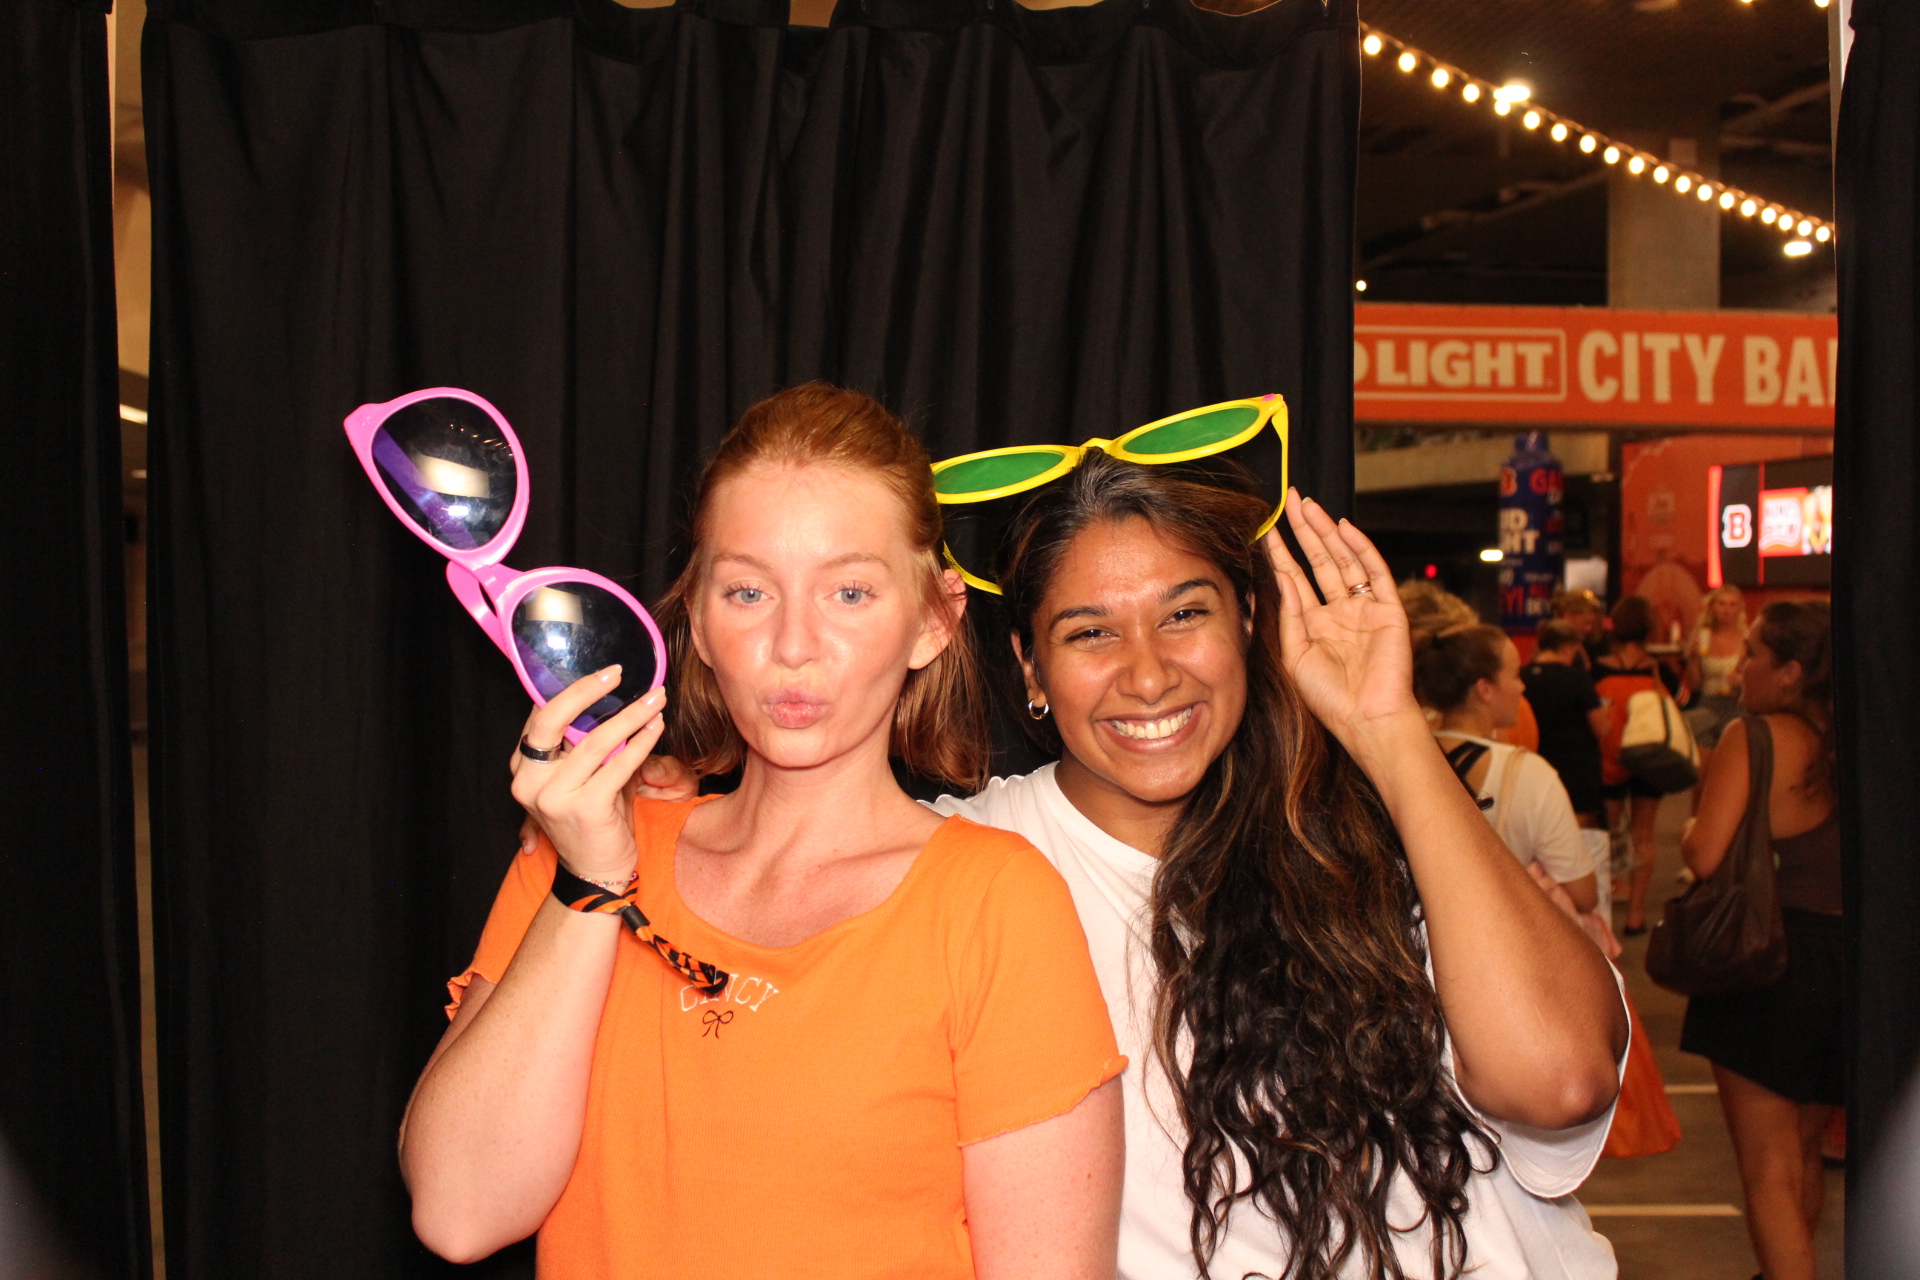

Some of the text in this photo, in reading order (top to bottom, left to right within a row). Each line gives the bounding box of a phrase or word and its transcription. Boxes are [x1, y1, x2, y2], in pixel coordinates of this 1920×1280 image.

[1376, 339, 1553, 388] LIGHT
[1578, 329, 1726, 405] CITY
[1722, 503, 1752, 548] B
